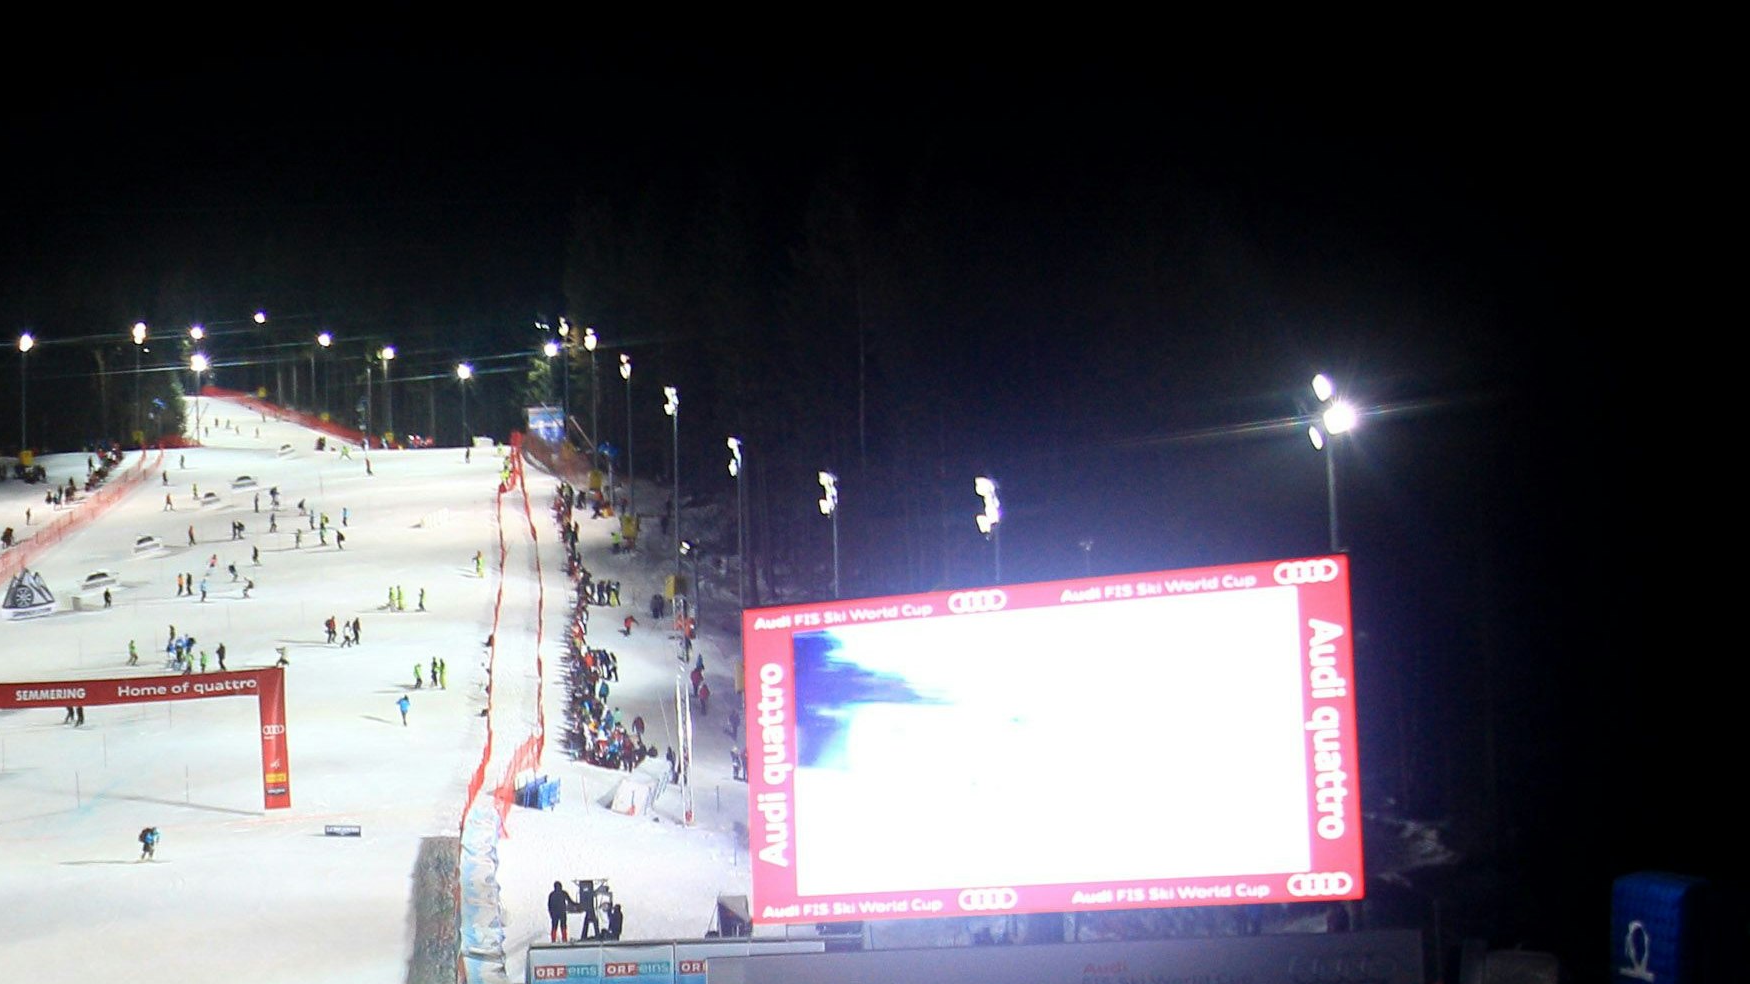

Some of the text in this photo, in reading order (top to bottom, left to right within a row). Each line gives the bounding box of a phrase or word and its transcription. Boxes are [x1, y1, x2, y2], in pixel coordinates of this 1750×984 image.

[1061, 574, 1256, 603] Audi FIS Ski World Cup
[754, 604, 933, 630] Audi FIS Ski World Cup
[15, 687, 86, 701] SEMMERING
[118, 678, 257, 697] Home of quattro
[1305, 617, 1348, 840] Audi quattro
[757, 662, 793, 868] Audi quattro
[1072, 882, 1270, 904] Audi FIS Ski World Cup
[762, 897, 943, 918] Audi FIS Ski World Cup
[536, 965, 597, 978] ORF eins
[607, 961, 670, 975] ORF eins
[1083, 961, 1128, 975] Audi
